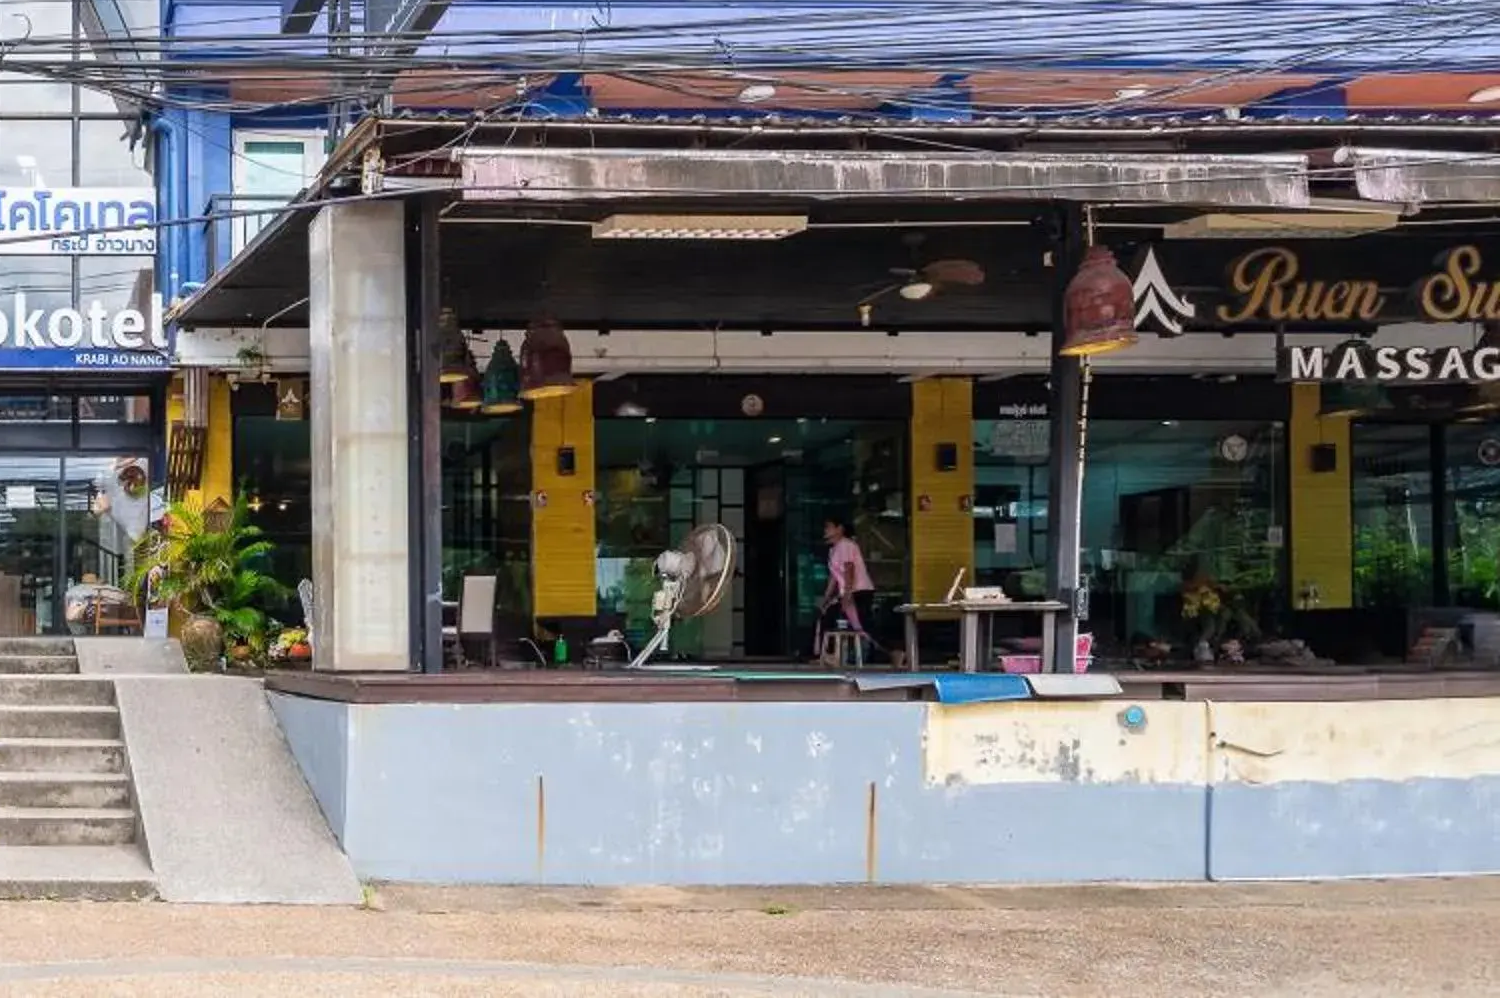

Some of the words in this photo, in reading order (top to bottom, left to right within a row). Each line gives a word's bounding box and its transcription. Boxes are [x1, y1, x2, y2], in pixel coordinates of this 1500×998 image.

[1218, 247, 1385, 323] Ruen
[75, 354, 108, 365] KRABI
[131, 355, 162, 366] NANG
[1291, 347, 1500, 380] MASSAG
